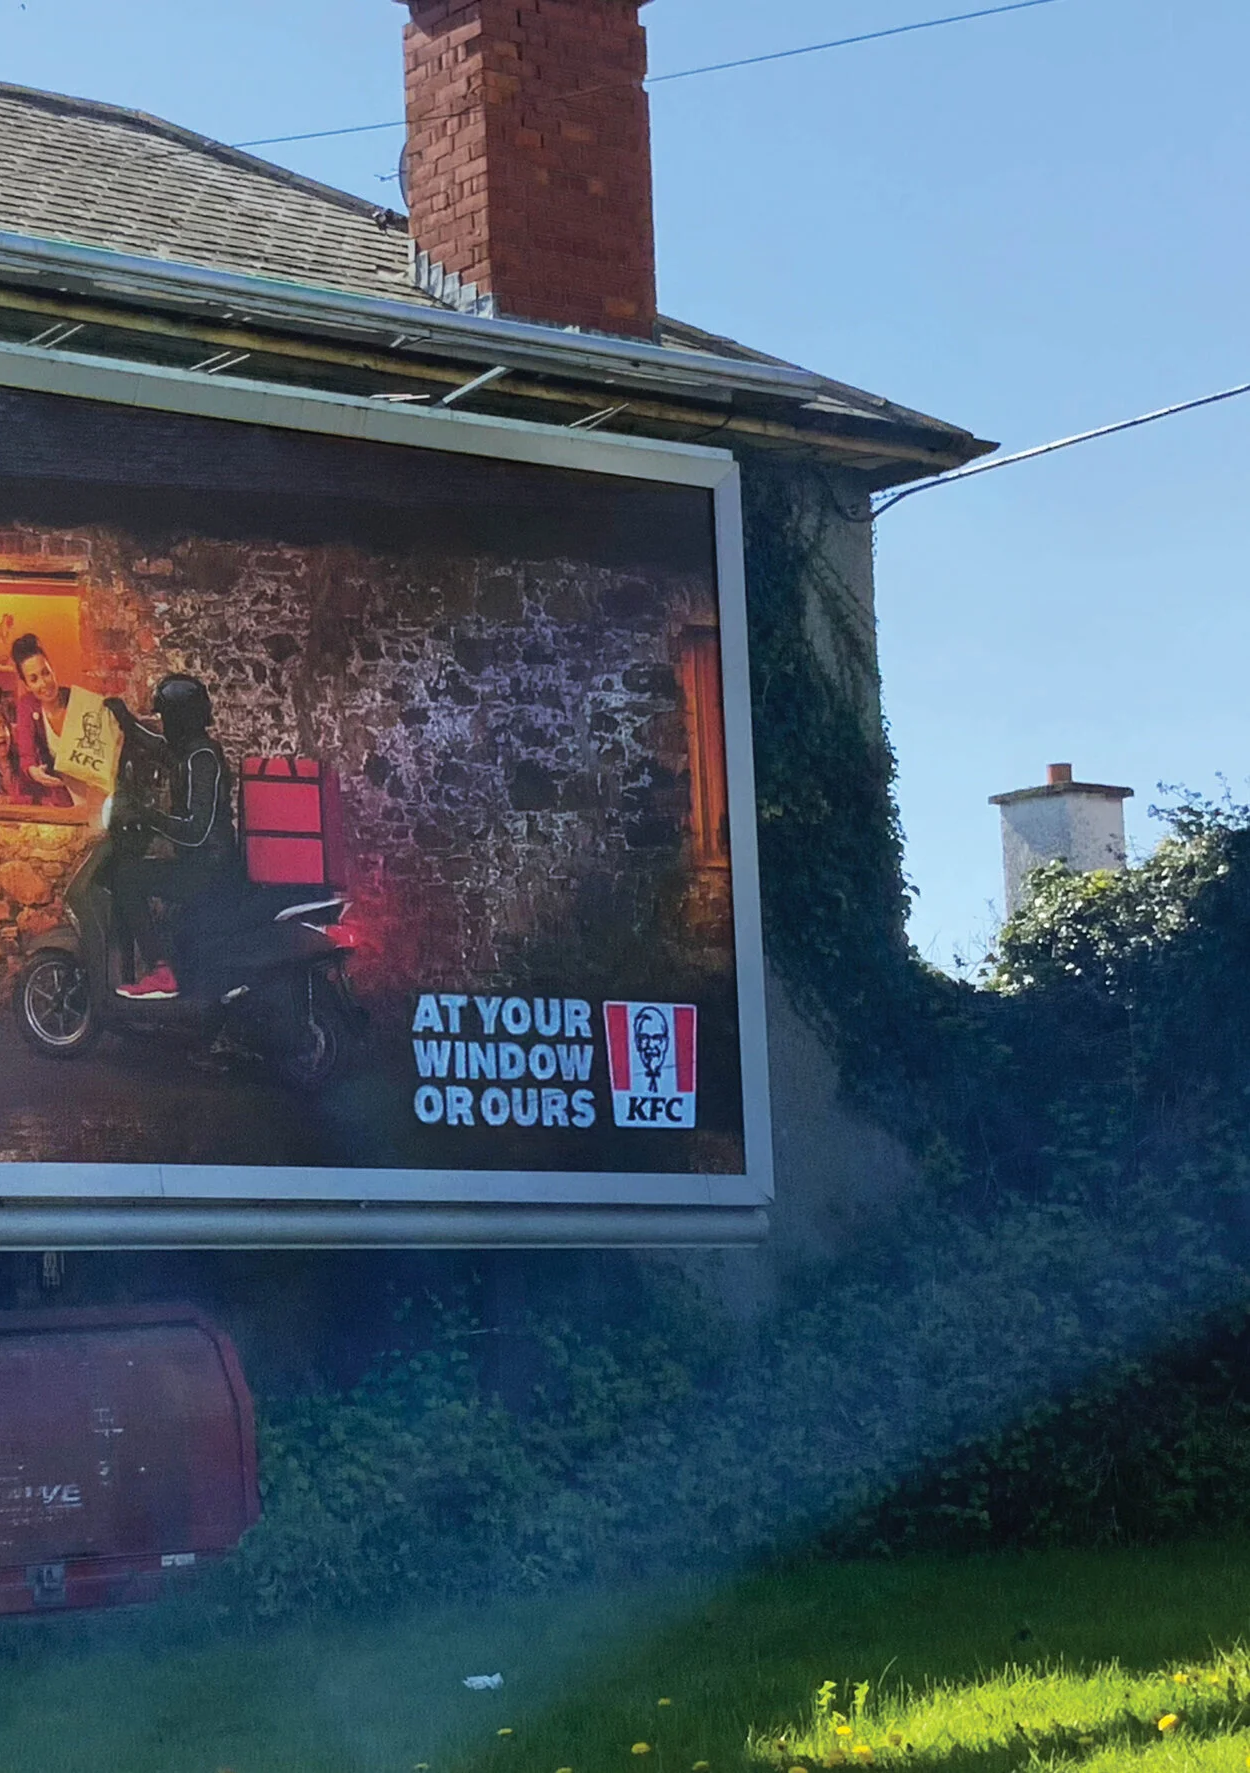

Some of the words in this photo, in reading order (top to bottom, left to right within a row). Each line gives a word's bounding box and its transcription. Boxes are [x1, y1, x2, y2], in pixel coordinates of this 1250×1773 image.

[70, 749, 103, 771] KFC
[412, 994, 468, 1034] AT
[474, 996, 592, 1037] YOUR
[412, 1039, 594, 1081] WINDOW
[414, 1084, 475, 1126] OR
[480, 1087, 596, 1128] OURS
[626, 1097, 684, 1122] KFC
